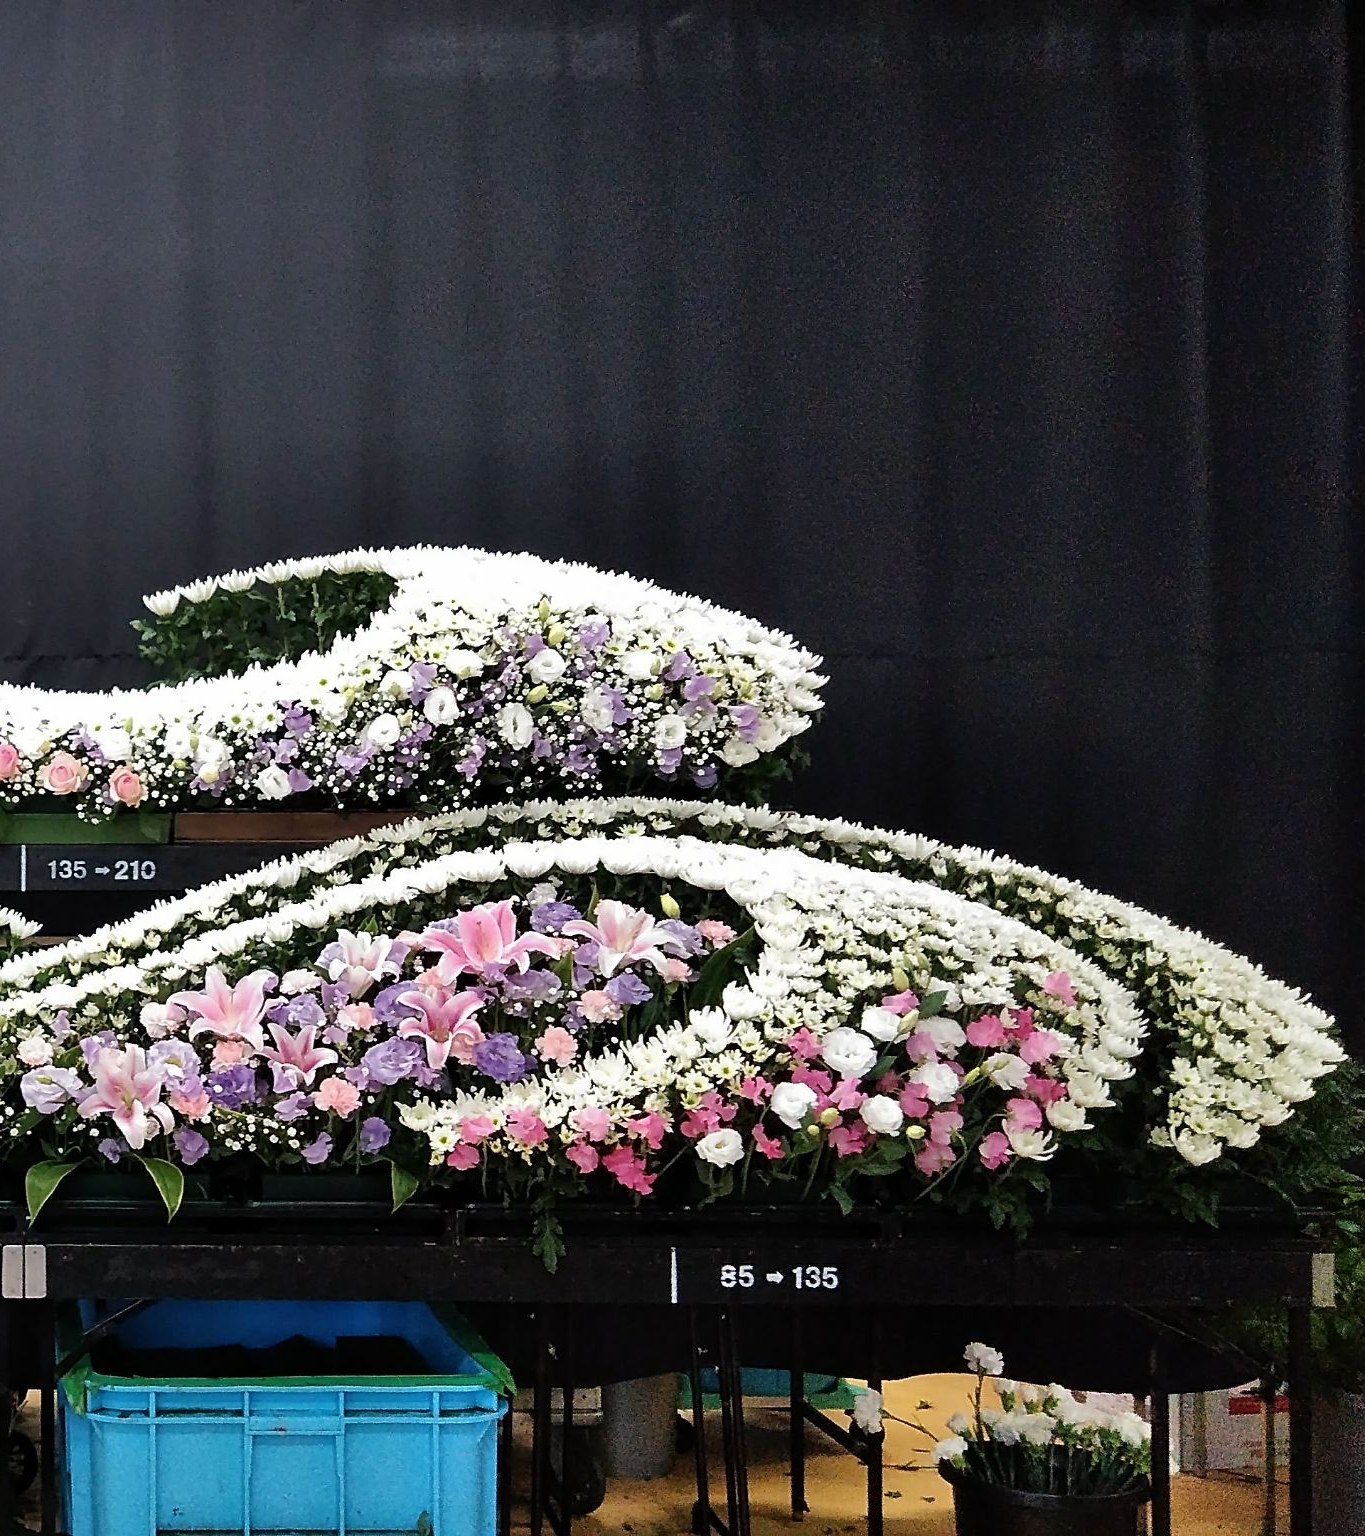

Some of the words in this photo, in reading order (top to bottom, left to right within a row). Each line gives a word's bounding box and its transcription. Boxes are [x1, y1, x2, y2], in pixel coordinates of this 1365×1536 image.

[47, 859, 87, 879] 135
[114, 860, 156, 880] 210
[720, 1265, 755, 1287] 85
[792, 1266, 839, 1289] 135
